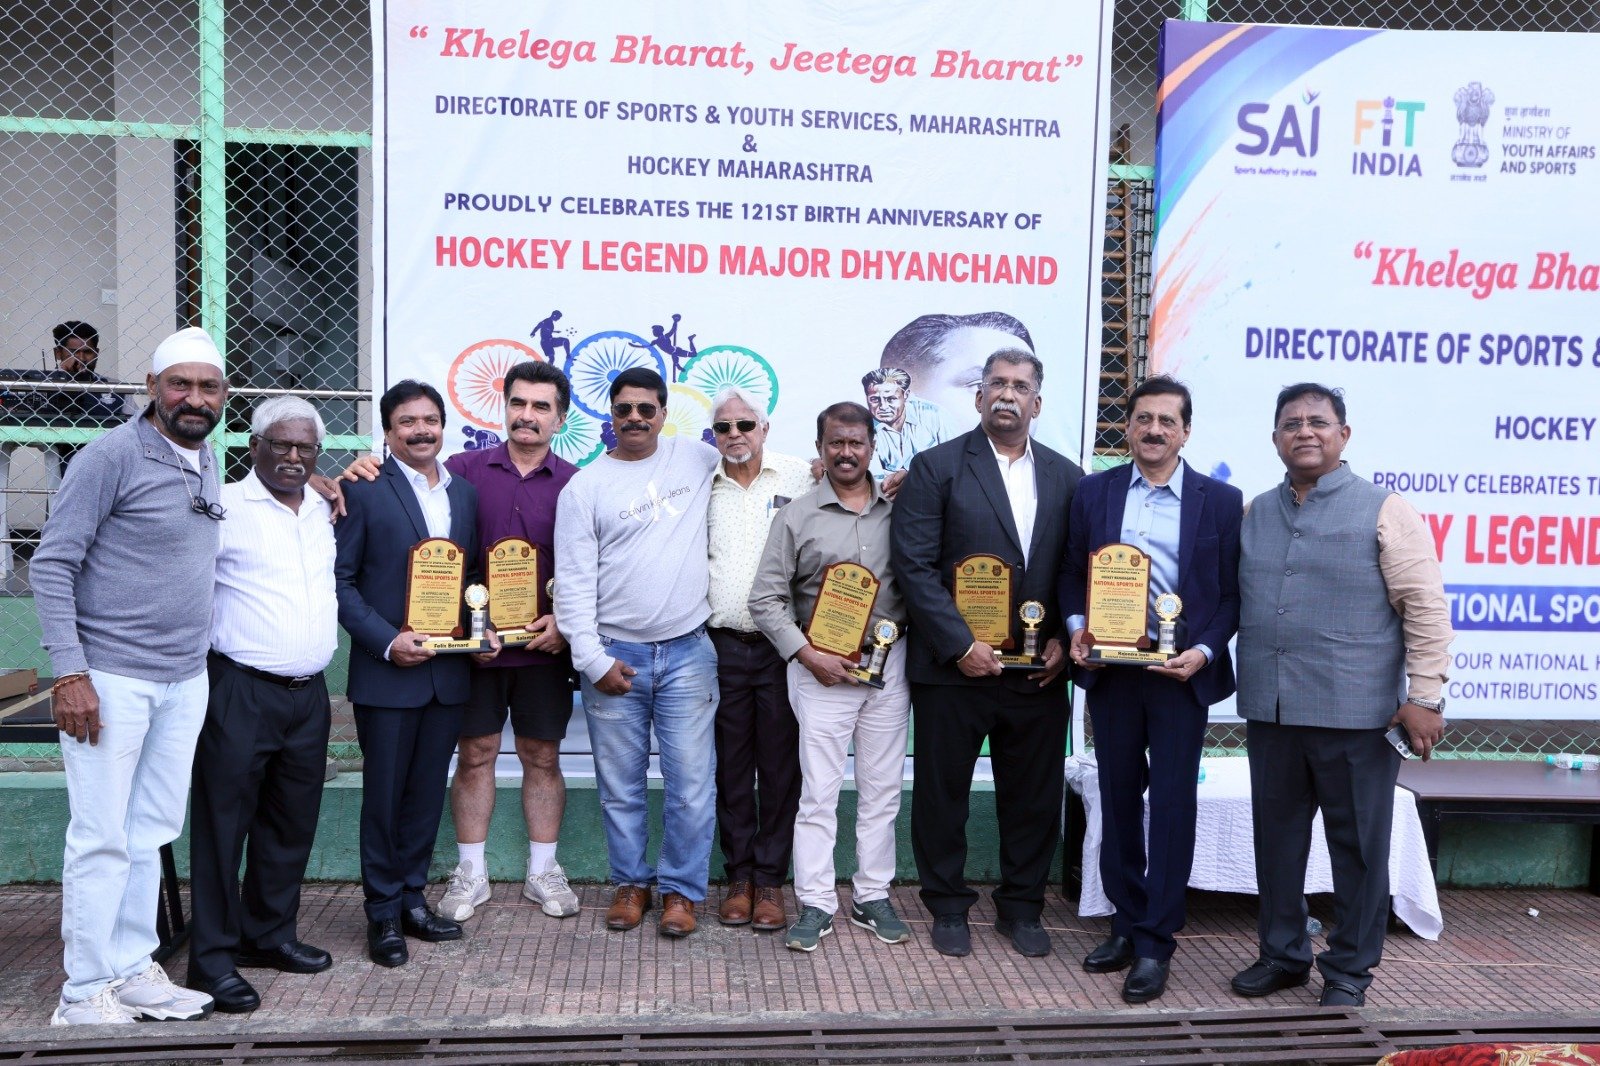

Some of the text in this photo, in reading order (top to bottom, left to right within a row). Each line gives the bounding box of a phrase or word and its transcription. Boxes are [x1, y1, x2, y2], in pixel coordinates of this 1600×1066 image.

[440, 27, 598, 69] Khelega
[610, 35, 753, 75] Bharat,
[770, 43, 917, 83] Jeetega
[931, 50, 1083, 82] Bharat”
[436, 95, 1060, 138] DIRECTORATE OF SPORTS & YOUTH SERVICES, MAHARASHTRA
[1235, 102, 1320, 157] SAI
[742, 134, 757, 152] &
[1503, 125, 1571, 139] MINISTRY OF
[1353, 152, 1422, 177] INDIA
[1502, 144, 1595, 159] YOUTH AFFAIRS
[628, 156, 873, 183] HOCKEY MAHARASHTRA
[1500, 161, 1576, 174] AND SPORTS
[445, 193, 1041, 230] PROUDLY CELEBRATES THE 121ST BIRTH ANNIVERSARY OF
[436, 236, 1057, 285] HOCKEY LEGEND MAJOR DHYANCHAND
[1354, 241, 1518, 300] “Khelega
[1246, 327, 1428, 363] DIRECTORATE
[1437, 332, 1471, 364] OF
[1479, 334, 1583, 367] SPORTS
[1495, 416, 1596, 440] HOCKEY
[1373, 472, 1459, 493] PROUDLY
[1465, 474, 1580, 495] CELEBRATES
[619, 502, 650, 520] Calvin
[668, 485, 691, 499] Jeans
[1455, 653, 1492, 669] OUR
[1500, 654, 1589, 671] NATIONAL
[1449, 681, 1597, 700] CONTRIBUTIONS
